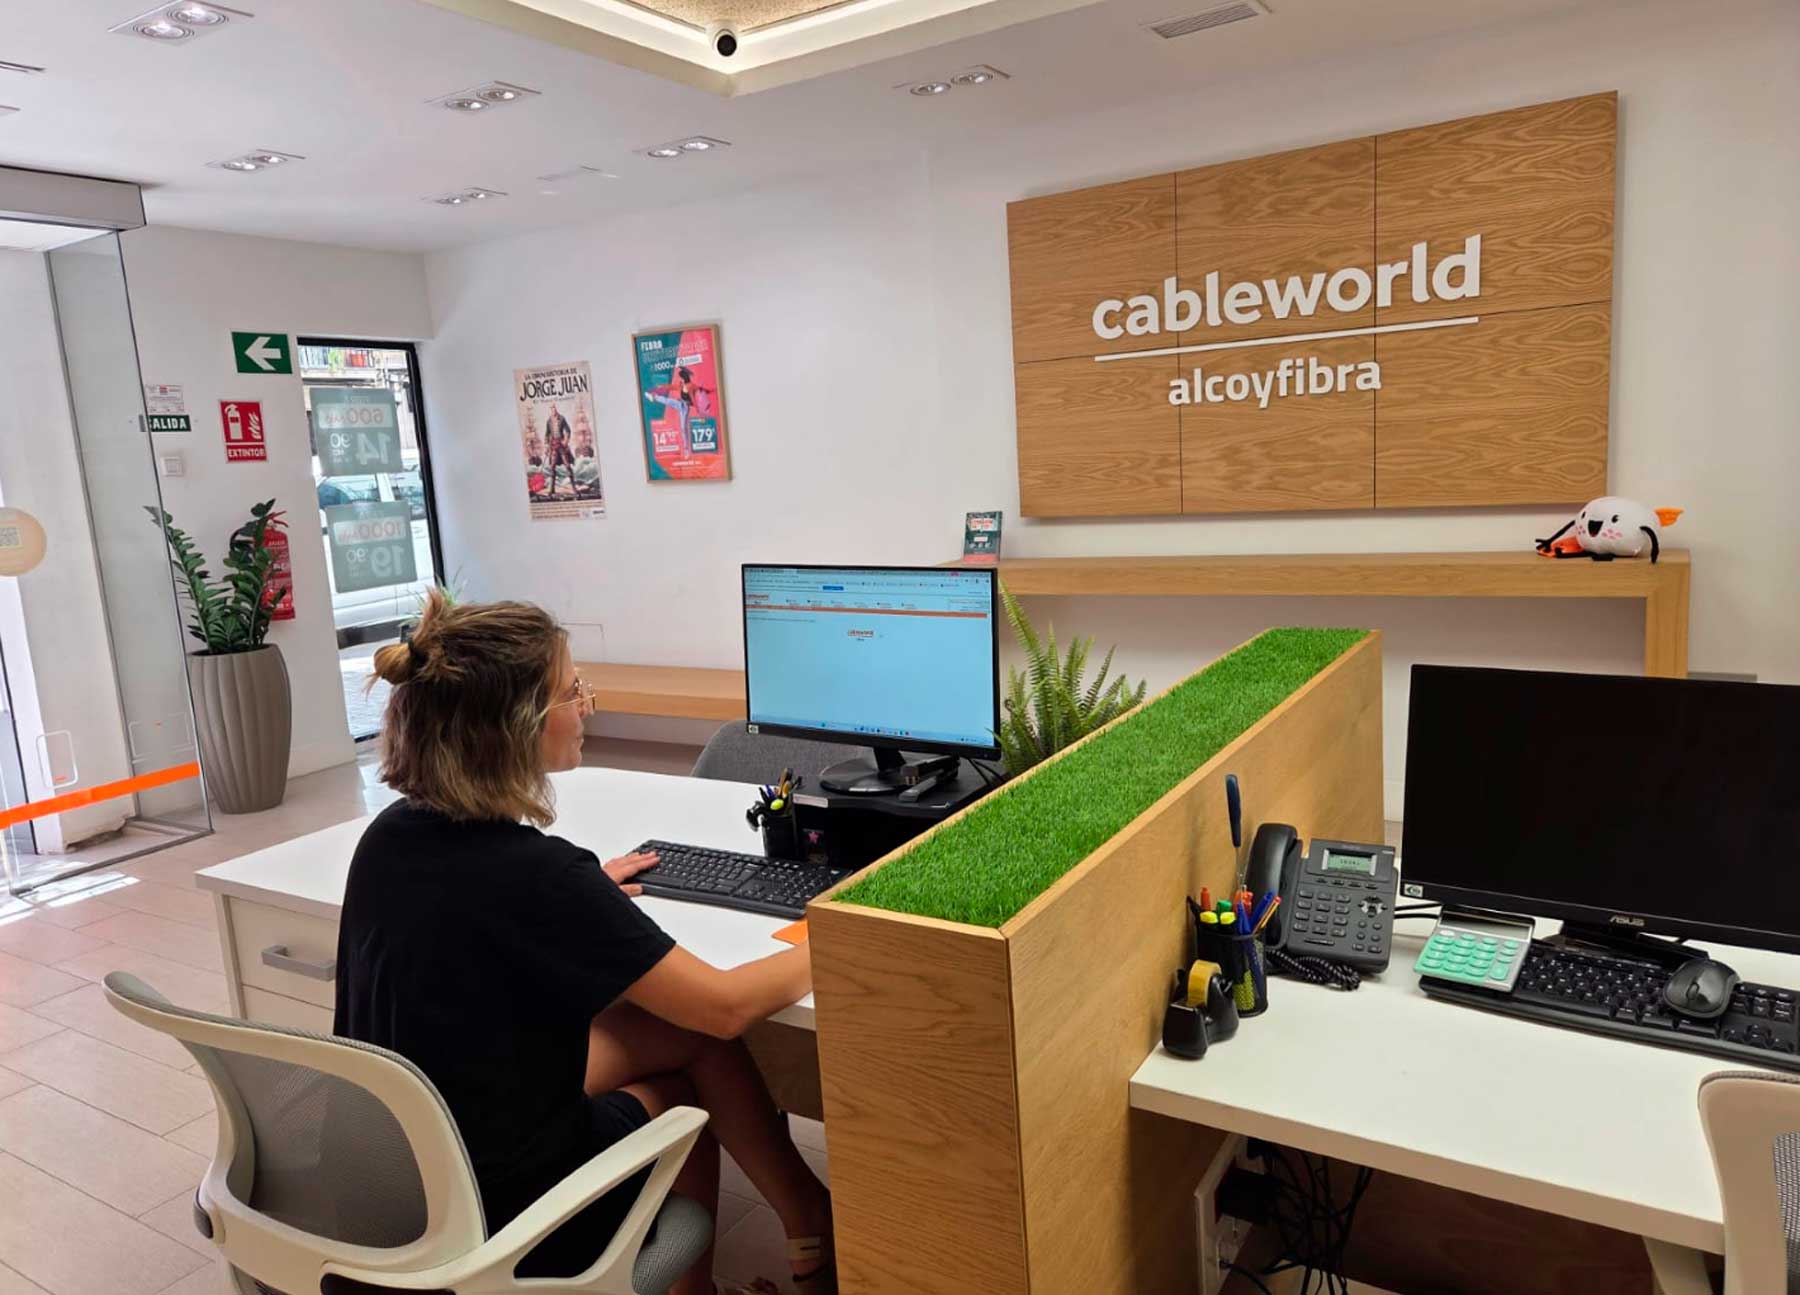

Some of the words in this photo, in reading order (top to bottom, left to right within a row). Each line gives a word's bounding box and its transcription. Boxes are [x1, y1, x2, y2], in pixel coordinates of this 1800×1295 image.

[1092, 234, 1481, 339] cableworld
[520, 379, 557, 402] JORGE
[558, 374, 588, 396] JUAN
[1168, 356, 1382, 409] alcoyfibra
[228, 448, 266, 458] EXTINTOR
[1610, 915, 1645, 927] ASUS
